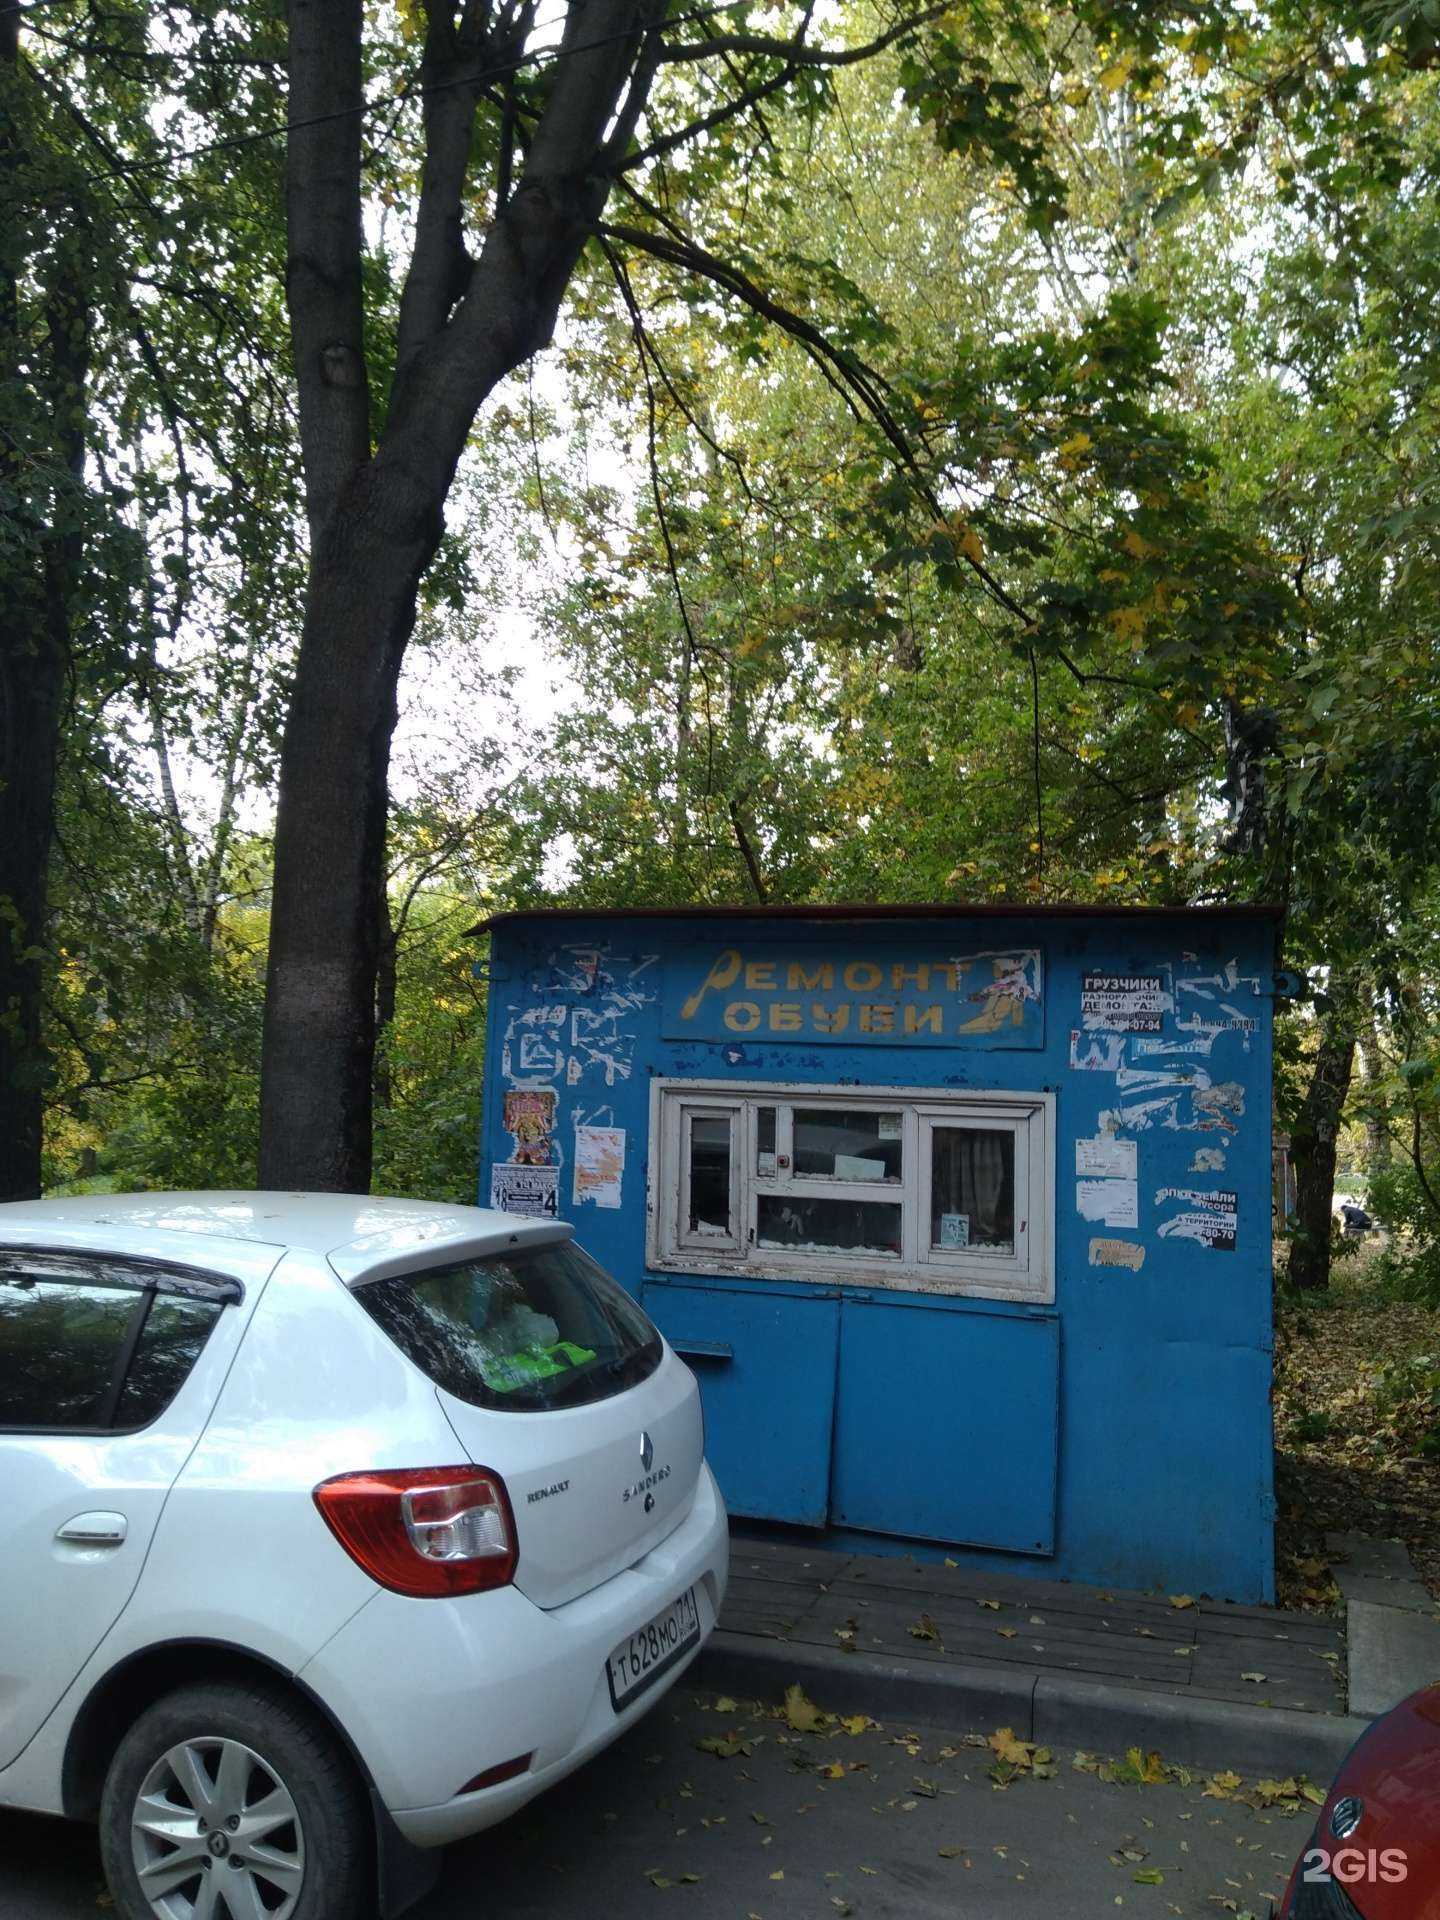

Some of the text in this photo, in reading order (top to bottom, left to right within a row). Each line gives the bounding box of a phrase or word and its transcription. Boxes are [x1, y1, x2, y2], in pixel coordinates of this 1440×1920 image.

[680, 949, 972, 1019] РЕМОНТ
[1085, 977, 1160, 991] ГРУЗЧИКИ
[723, 1001, 944, 1034] ОБУВИ
[527, 1480, 570, 1504] RENAULT
[622, 1465, 672, 1502] SANDERO
